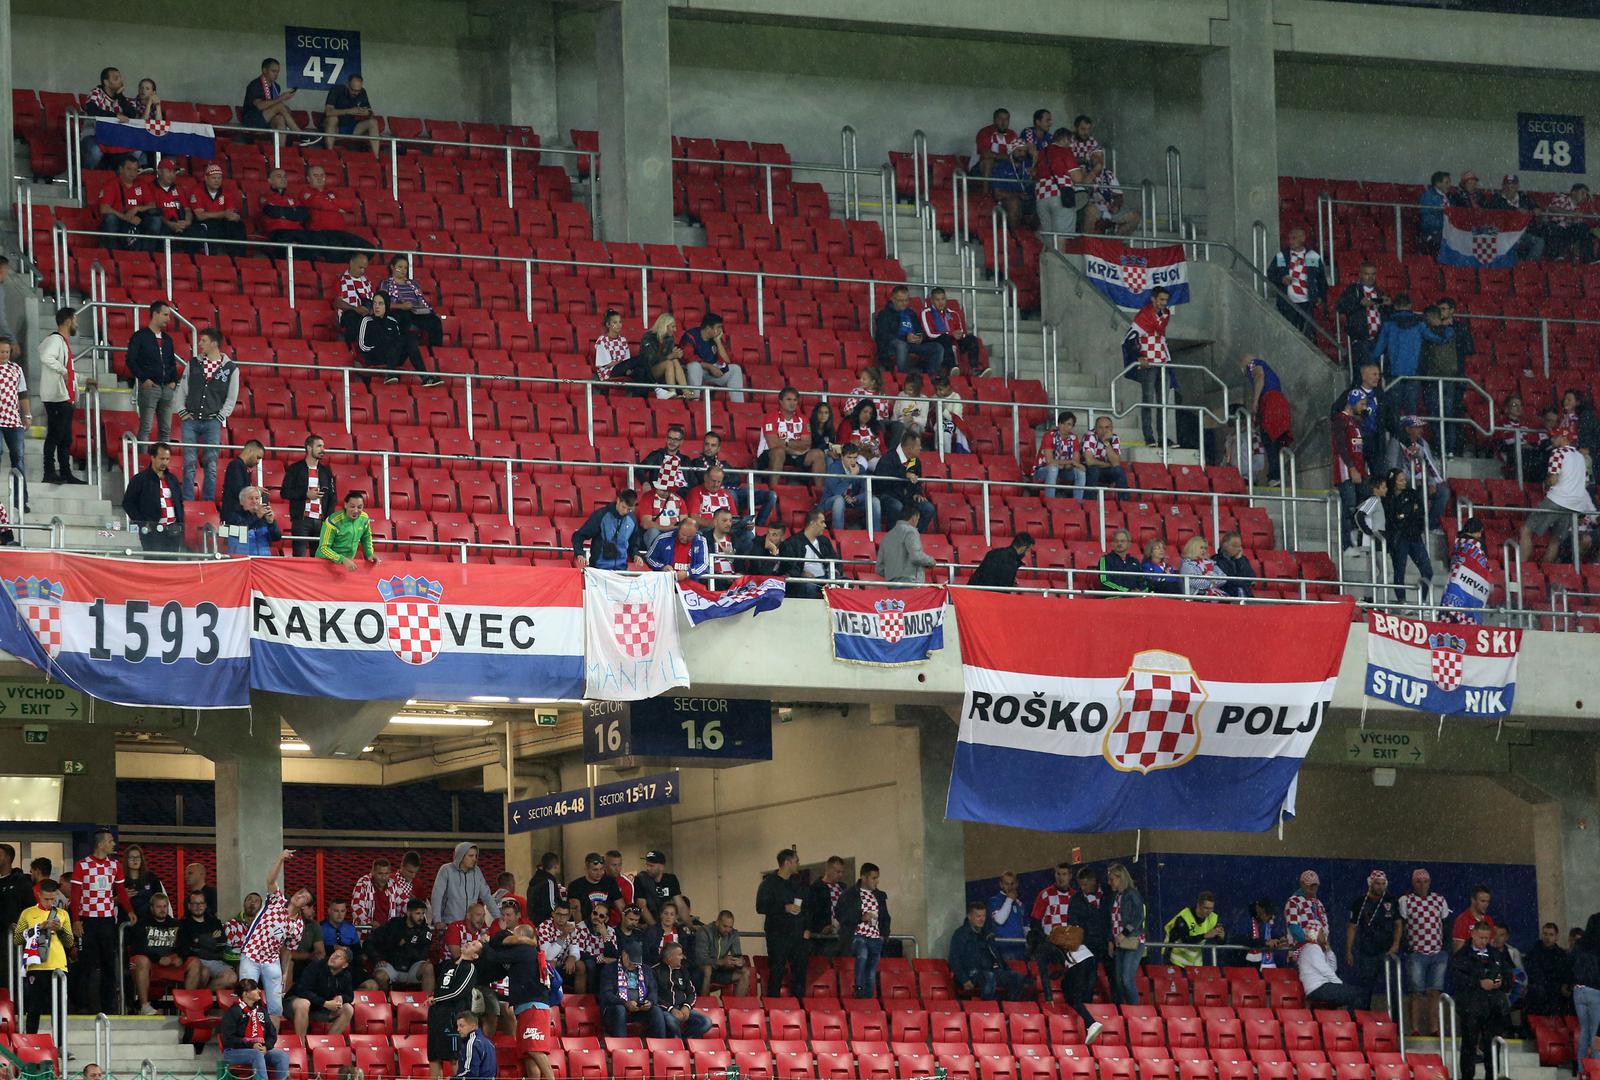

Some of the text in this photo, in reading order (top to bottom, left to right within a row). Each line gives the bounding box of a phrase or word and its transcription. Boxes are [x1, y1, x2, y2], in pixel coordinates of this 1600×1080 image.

[297, 34, 349, 51] SECTOR
[303, 55, 345, 85] 47
[1528, 120, 1575, 134] SECTOR
[1533, 139, 1572, 167] 48
[1087, 260, 1120, 280] KRIŽ
[88, 597, 220, 666] 1593
[253, 596, 536, 650] RAKO VEC
[1373, 612, 1517, 654] BROD SKI
[7, 685, 65, 700] VÝCHOD
[1372, 670, 1507, 714] STUP NIK
[21, 703, 51, 715] EXIT
[589, 700, 624, 717] SECTOR
[673, 697, 729, 713] SECTOR
[968, 690, 1108, 734] ROŠKO
[594, 719, 622, 753] 16
[681, 719, 725, 751] 16
[1360, 731, 1410, 745] VÝCHOD
[1373, 748, 1399, 759] EXIT
[599, 783, 657, 807] SECTOR 15-17
[528, 797, 585, 820] SECTOR 46-48
